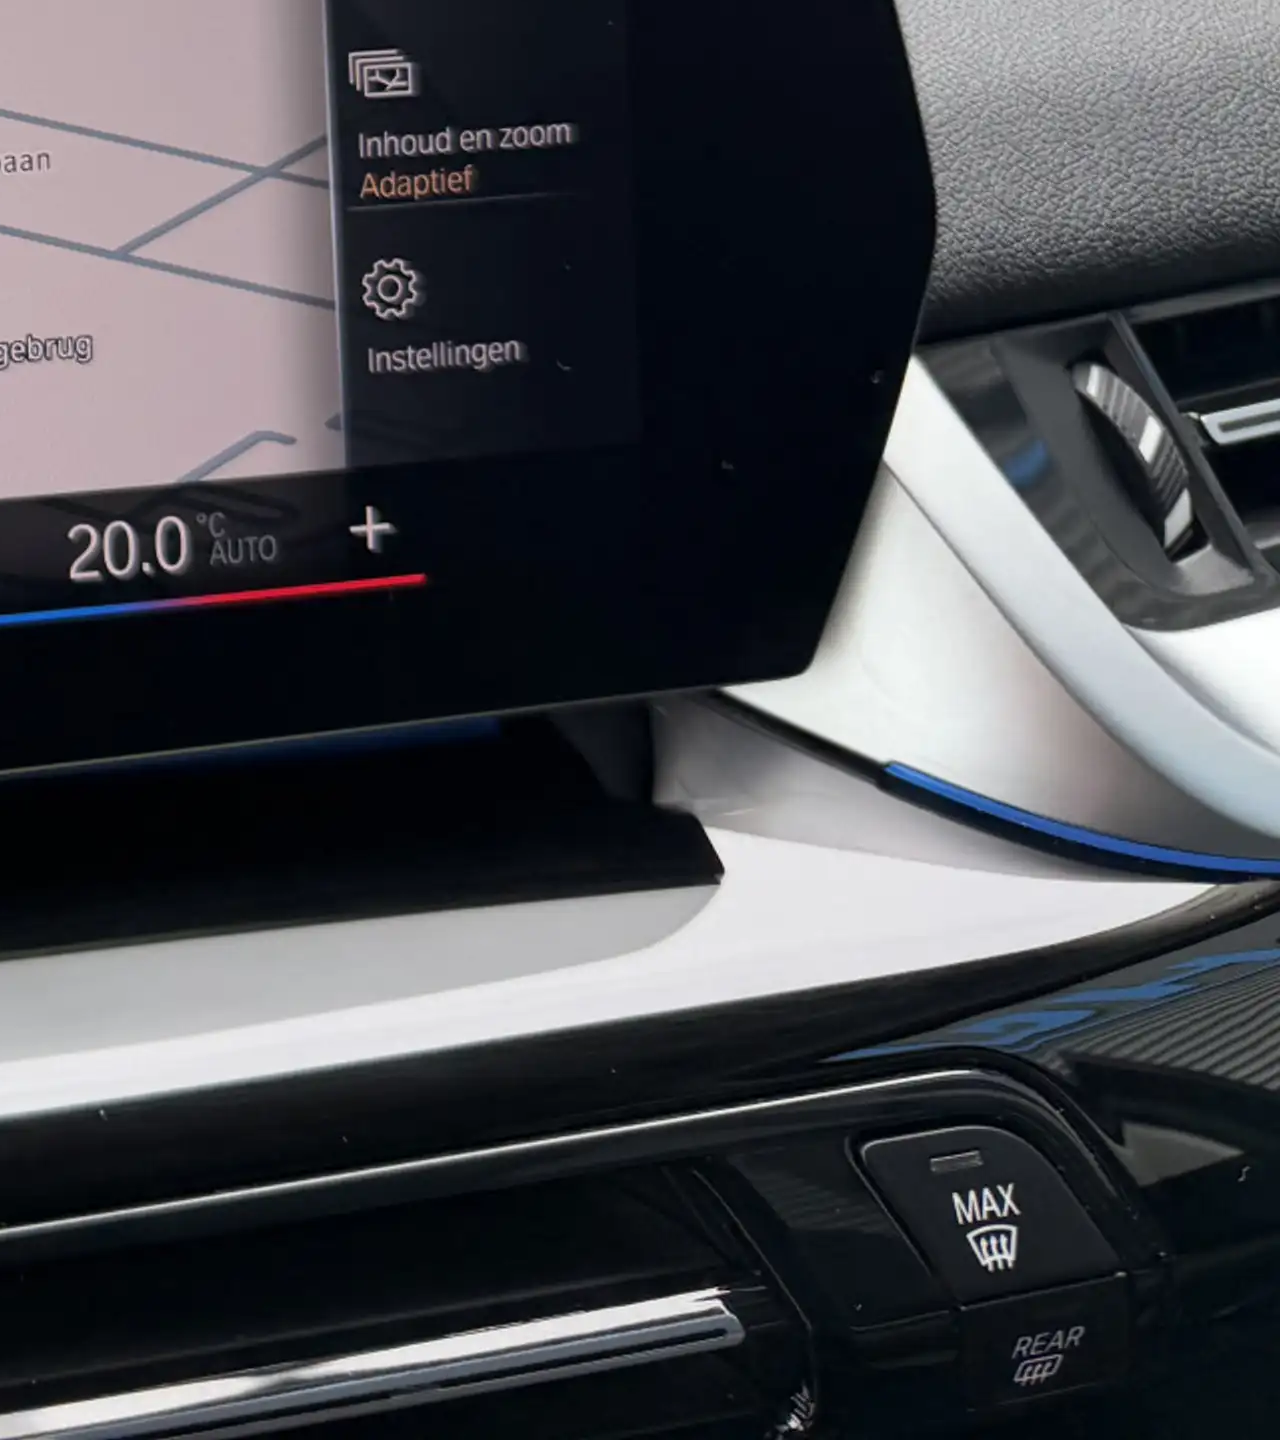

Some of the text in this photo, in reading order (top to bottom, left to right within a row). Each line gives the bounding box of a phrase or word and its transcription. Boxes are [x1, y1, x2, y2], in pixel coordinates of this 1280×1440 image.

[359, 123, 572, 158] Inhoud en zoom
[359, 166, 474, 201] Adaptief
[367, 337, 523, 374] Instellingen
[67, 515, 193, 582] 20.0
[209, 534, 278, 567] AUTO
[952, 1182, 1022, 1225] MAX
[1012, 1325, 1085, 1359] REAR
